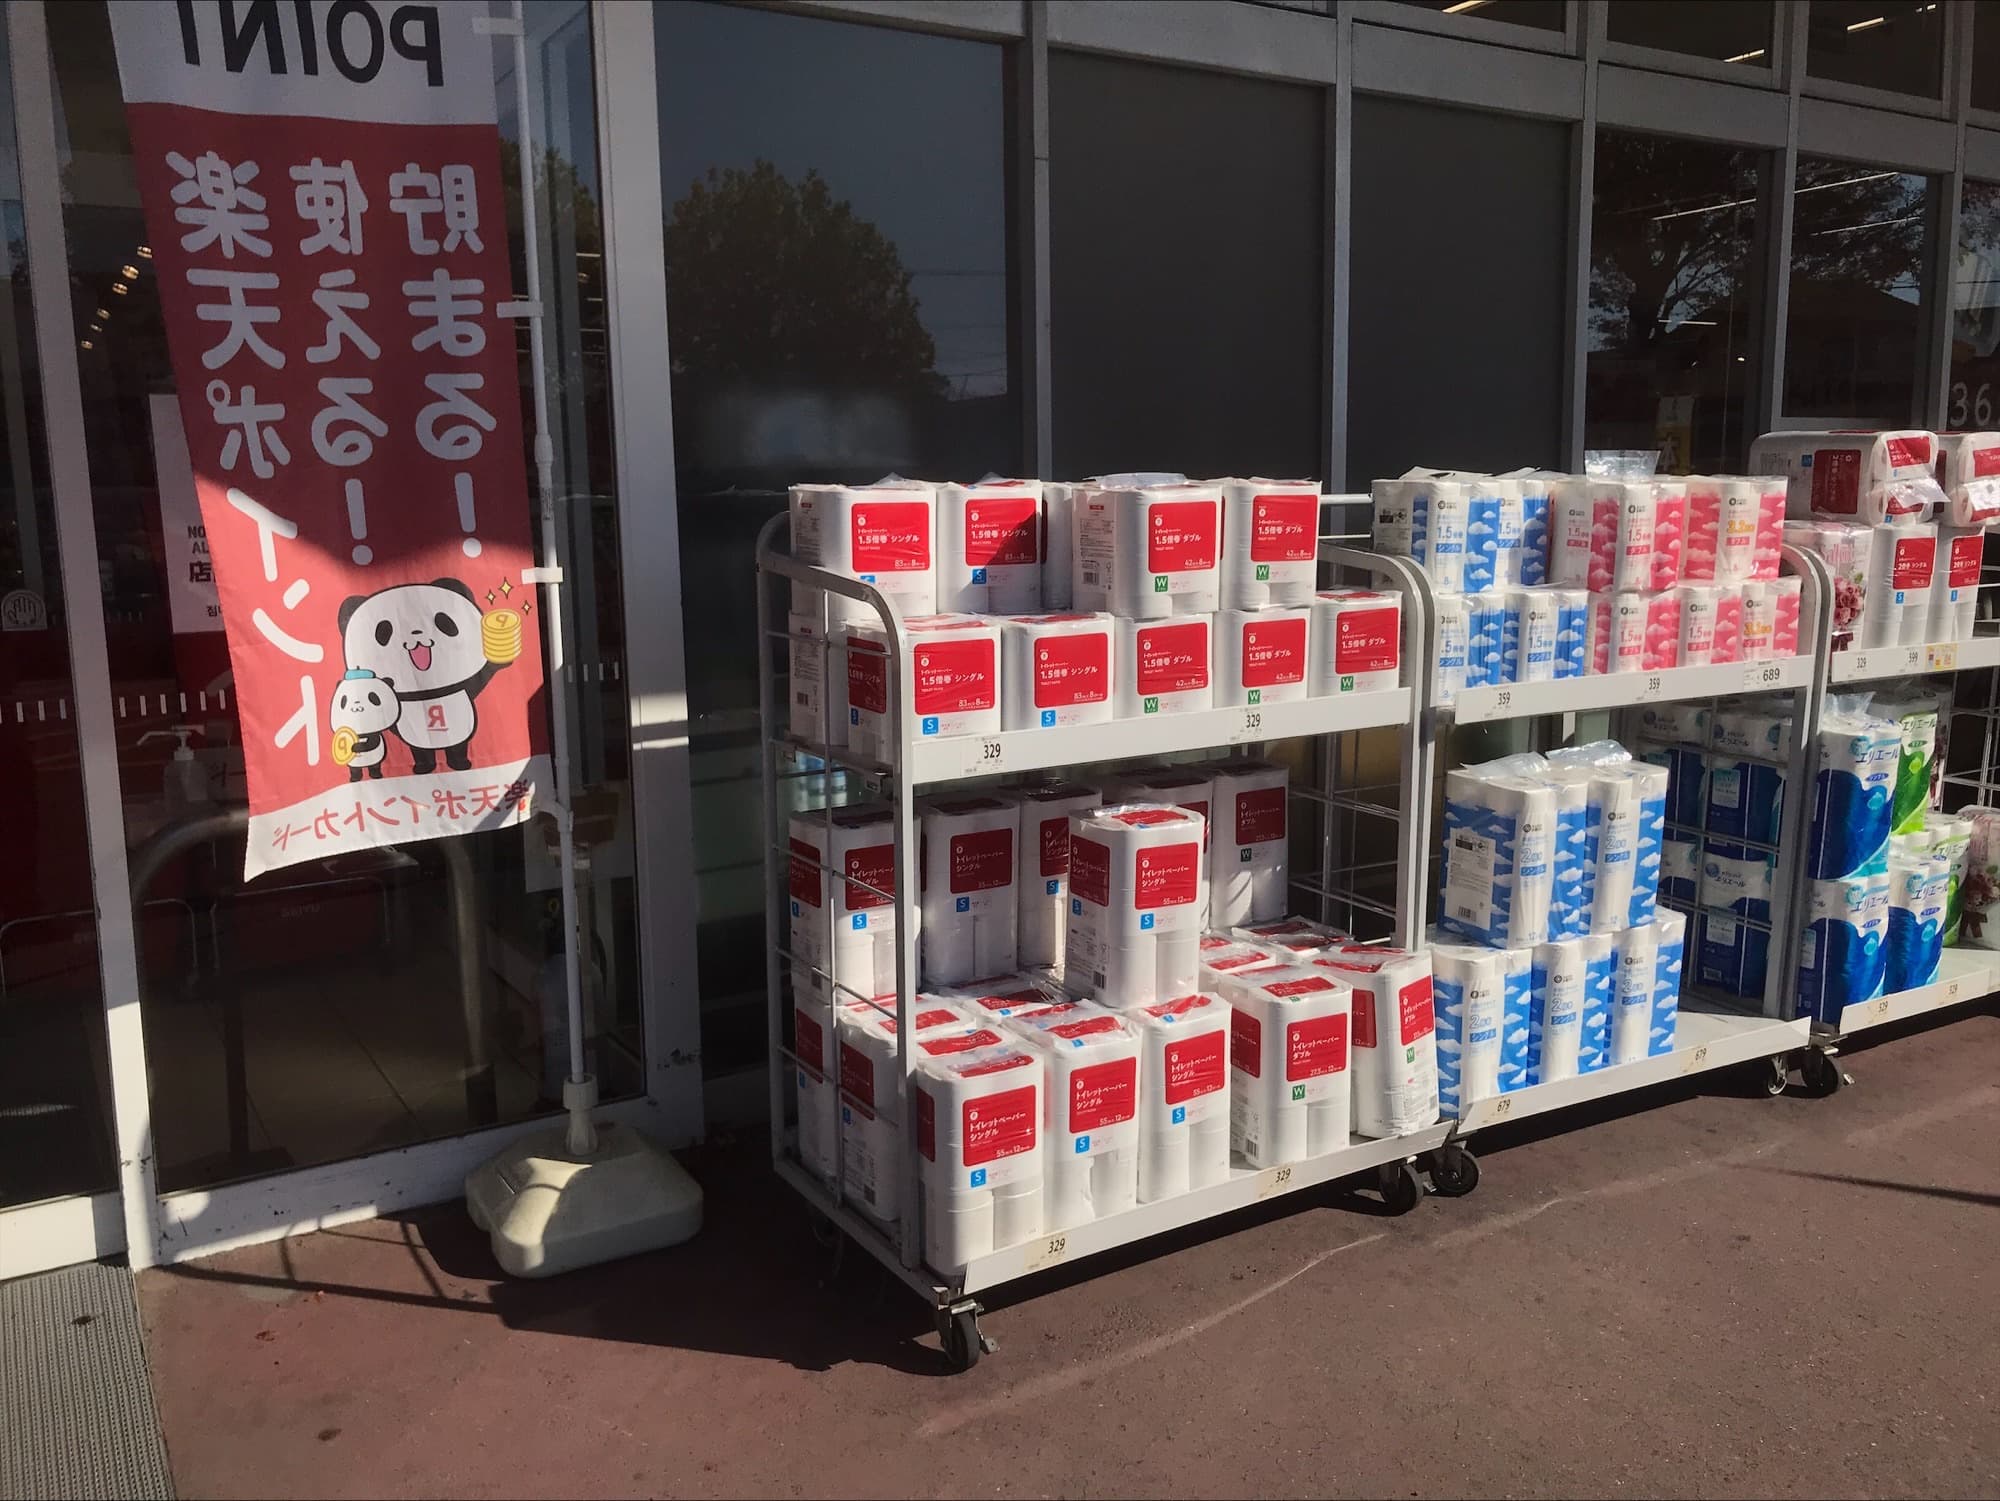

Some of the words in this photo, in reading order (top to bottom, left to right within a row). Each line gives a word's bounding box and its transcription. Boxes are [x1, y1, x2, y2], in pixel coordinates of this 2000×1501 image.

[192, 542, 210, 554] AL
[1763, 668, 1780, 682] 689
[1498, 692, 1510, 705] 359
[1246, 714, 1260, 728] 329
[1902, 718, 1936, 733] エリエール
[984, 744, 1000, 759] 329
[1856, 748, 1898, 765] エリエール
[851, 866, 894, 880] トイレットペー
[1142, 866, 1190, 878] トイレットペーパー
[1142, 880, 1166, 888] シングル
[856, 916, 863, 926] S
[1292, 1036, 1340, 1051] トイレットペーパー
[1292, 1051, 1311, 1060] ダブル
[1172, 1054, 1216, 1072] トイレットペーパー
[1172, 1070, 1195, 1082] シングル
[1076, 1083, 1128, 1100] トイレットペーパー
[1076, 1097, 1102, 1110] シングル
[1497, 1099, 1511, 1112] 679
[970, 1112, 1026, 1132] トイレットペーパー
[970, 1128, 999, 1142] シングル
[1276, 1168, 1291, 1183] 329
[1048, 1238, 1066, 1254] 329
